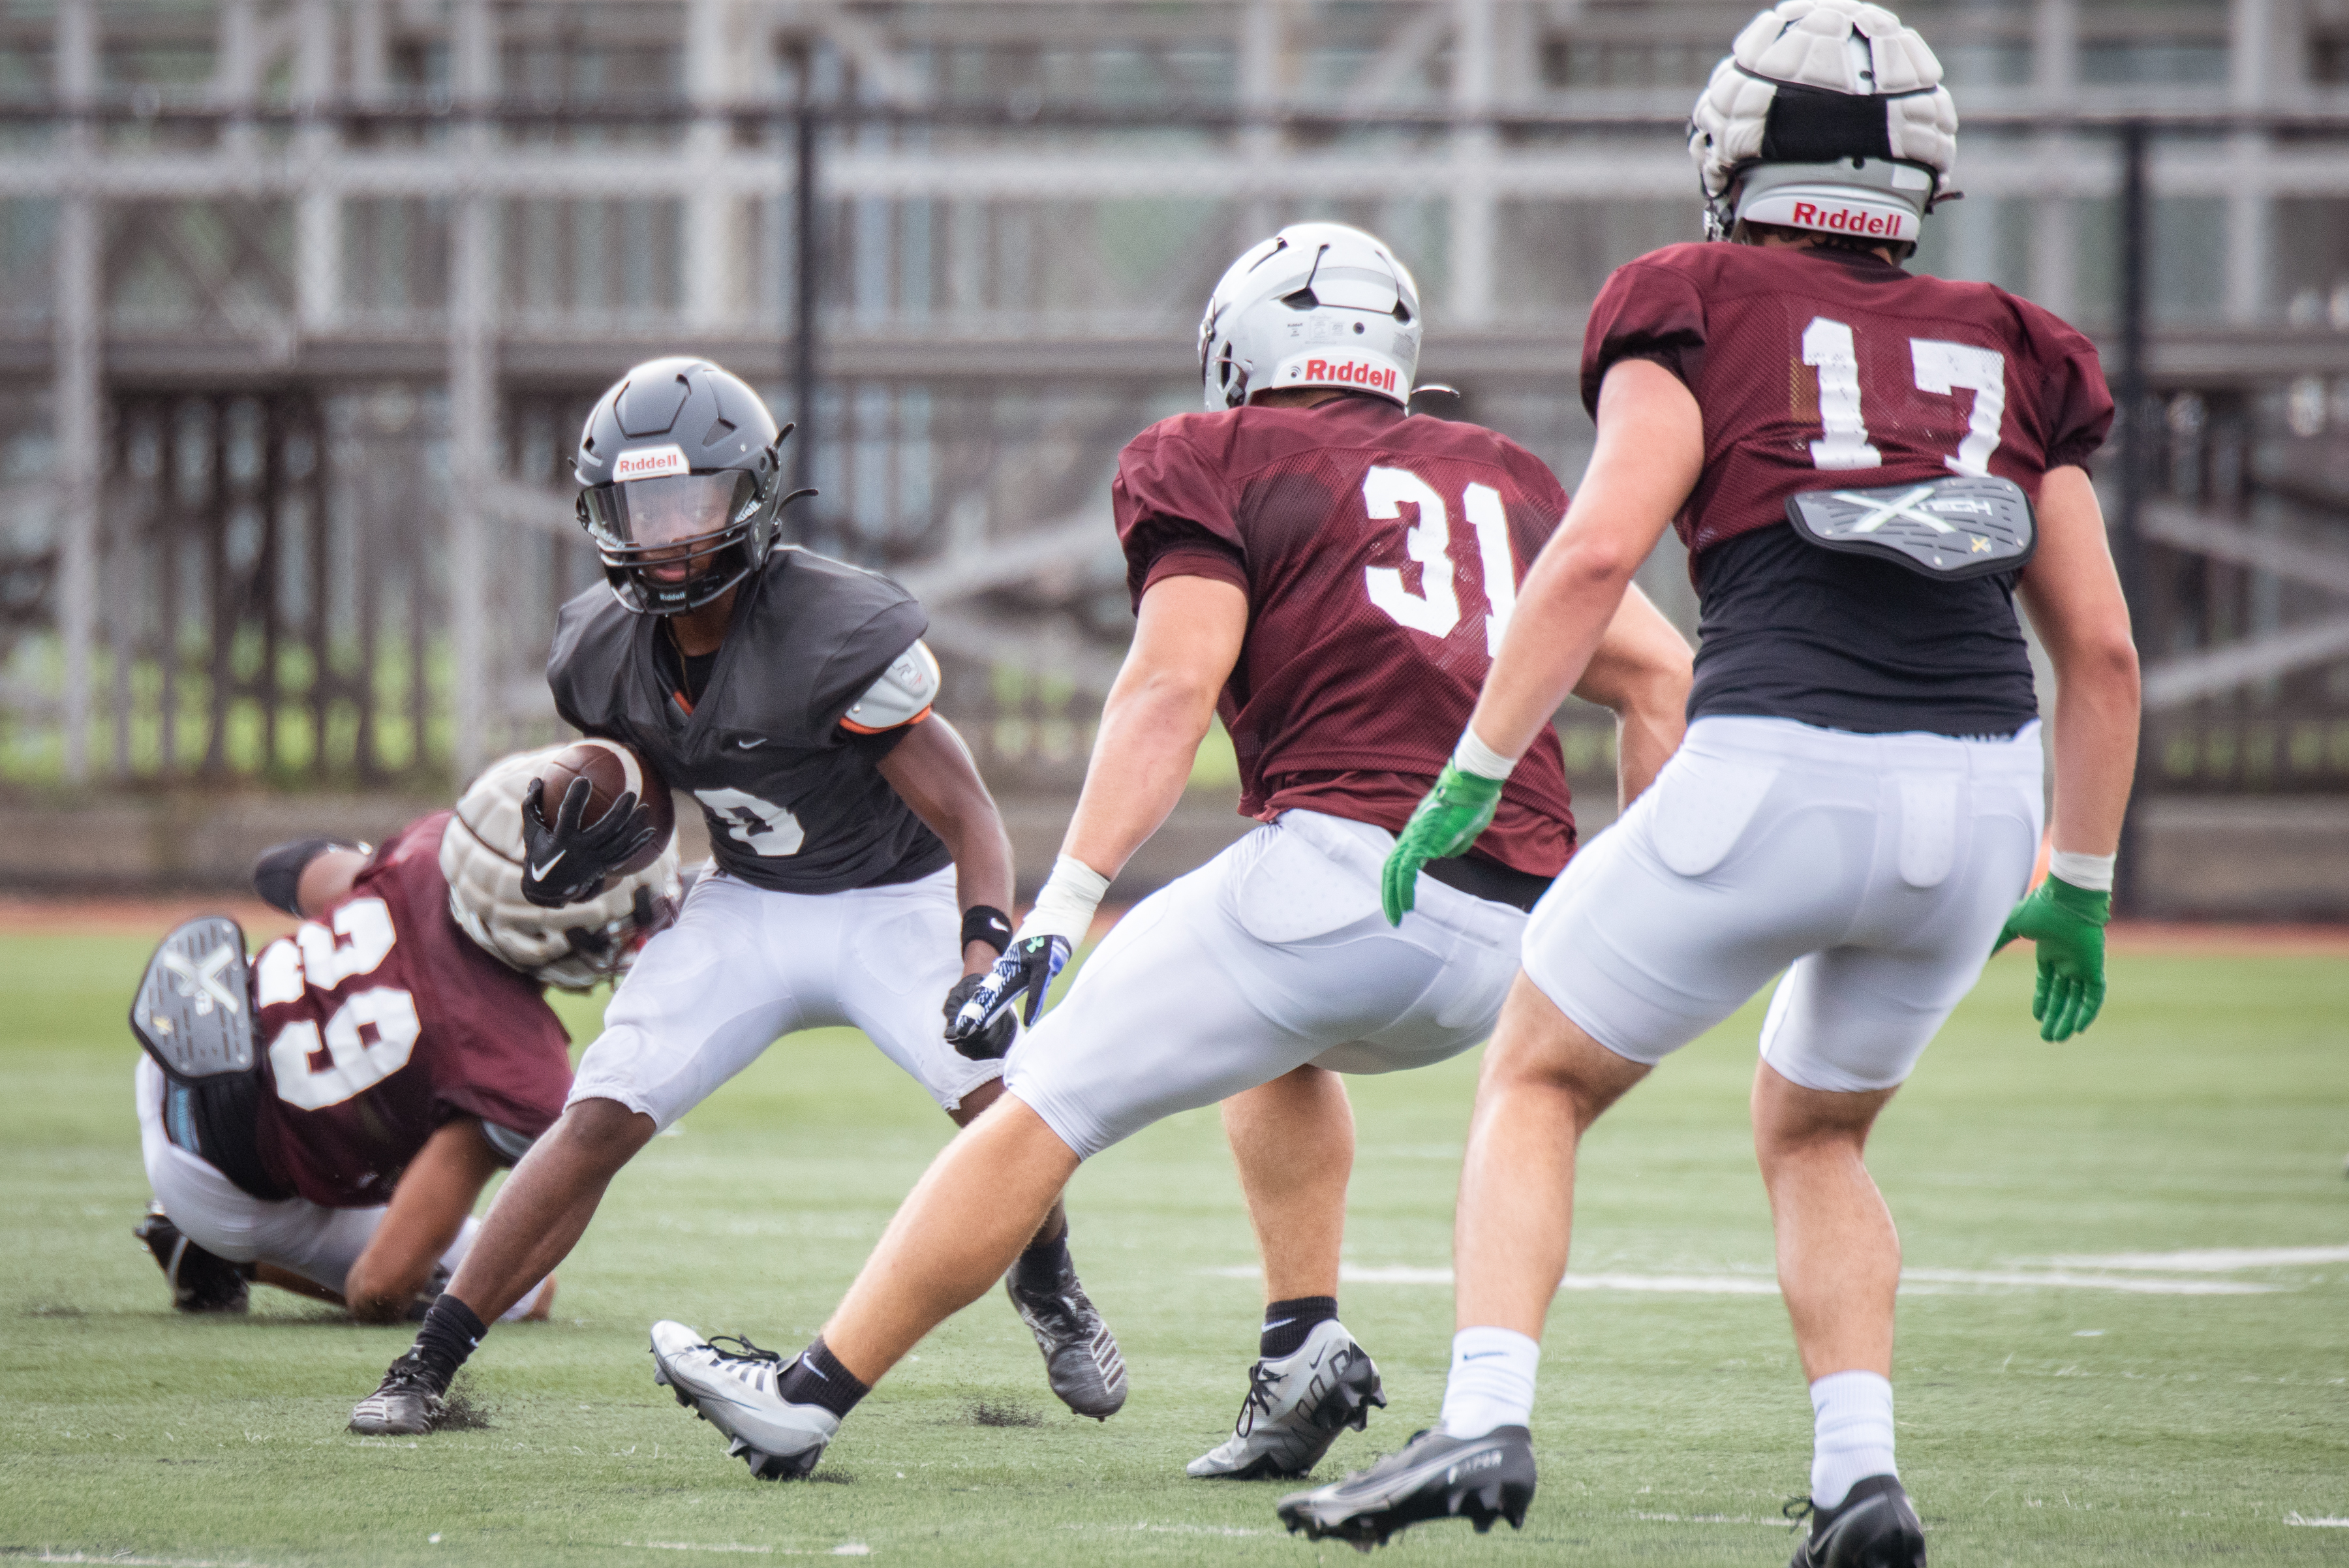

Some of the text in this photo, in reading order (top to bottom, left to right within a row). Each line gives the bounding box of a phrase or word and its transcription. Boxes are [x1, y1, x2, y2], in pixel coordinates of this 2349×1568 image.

[1793, 202, 1902, 236] Riddell
[1305, 360, 1396, 392] Riddell
[1802, 316, 2006, 478] 17
[620, 454, 677, 473] Riddell
[1361, 465, 1517, 660] 31
[659, 591, 685, 600] Riddell
[258, 897, 422, 1111] 29
